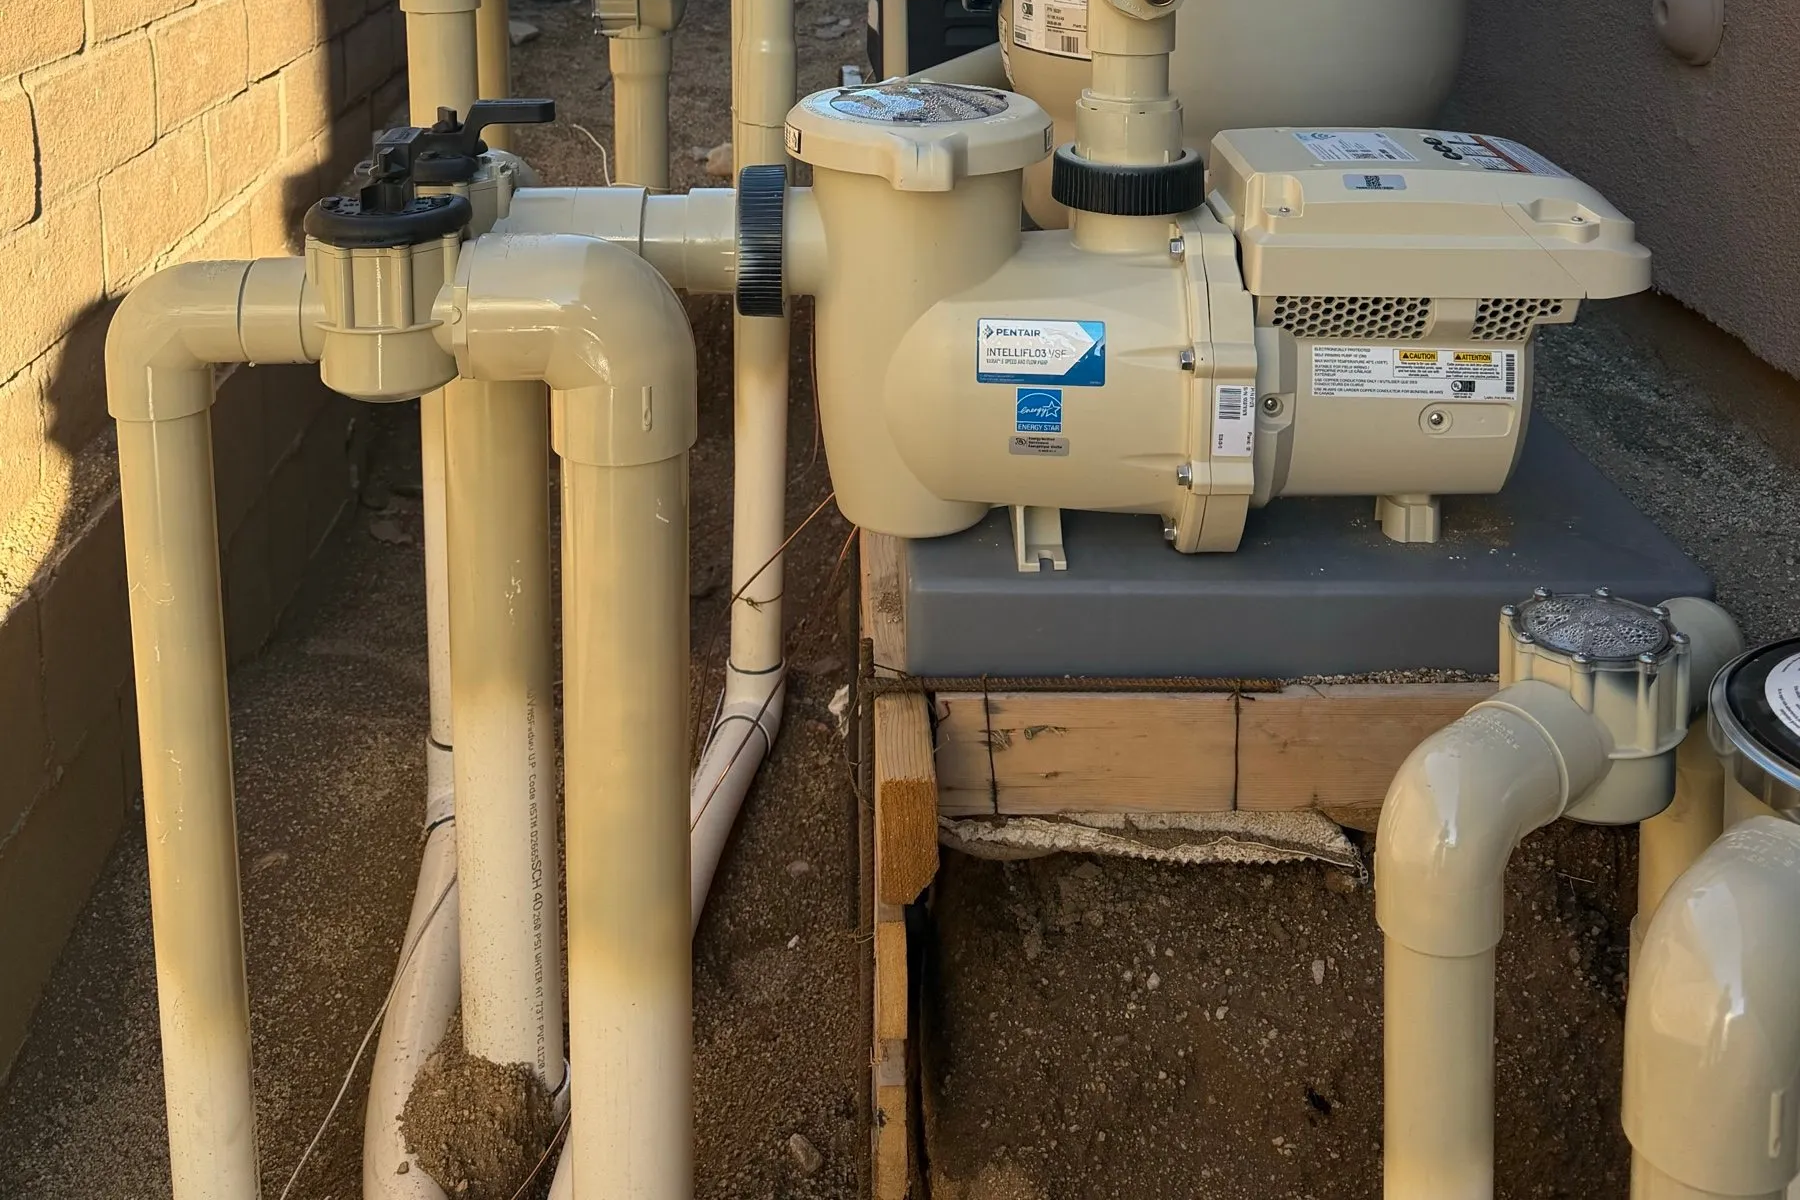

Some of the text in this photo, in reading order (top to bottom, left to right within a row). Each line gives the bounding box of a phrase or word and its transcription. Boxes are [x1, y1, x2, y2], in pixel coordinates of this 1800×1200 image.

[996, 329, 1040, 337] PENTAIR
[986, 348, 1046, 358] INTELLIFLO3
[529, 774, 537, 800] Code
[529, 802, 538, 829] ASTM
[532, 860, 542, 890] SCH
[533, 892, 543, 911] 40
[533, 912, 542, 931] 260
[535, 952, 543, 984] WATER
[536, 986, 543, 999] AT
[536, 1024, 544, 1044] PVC
